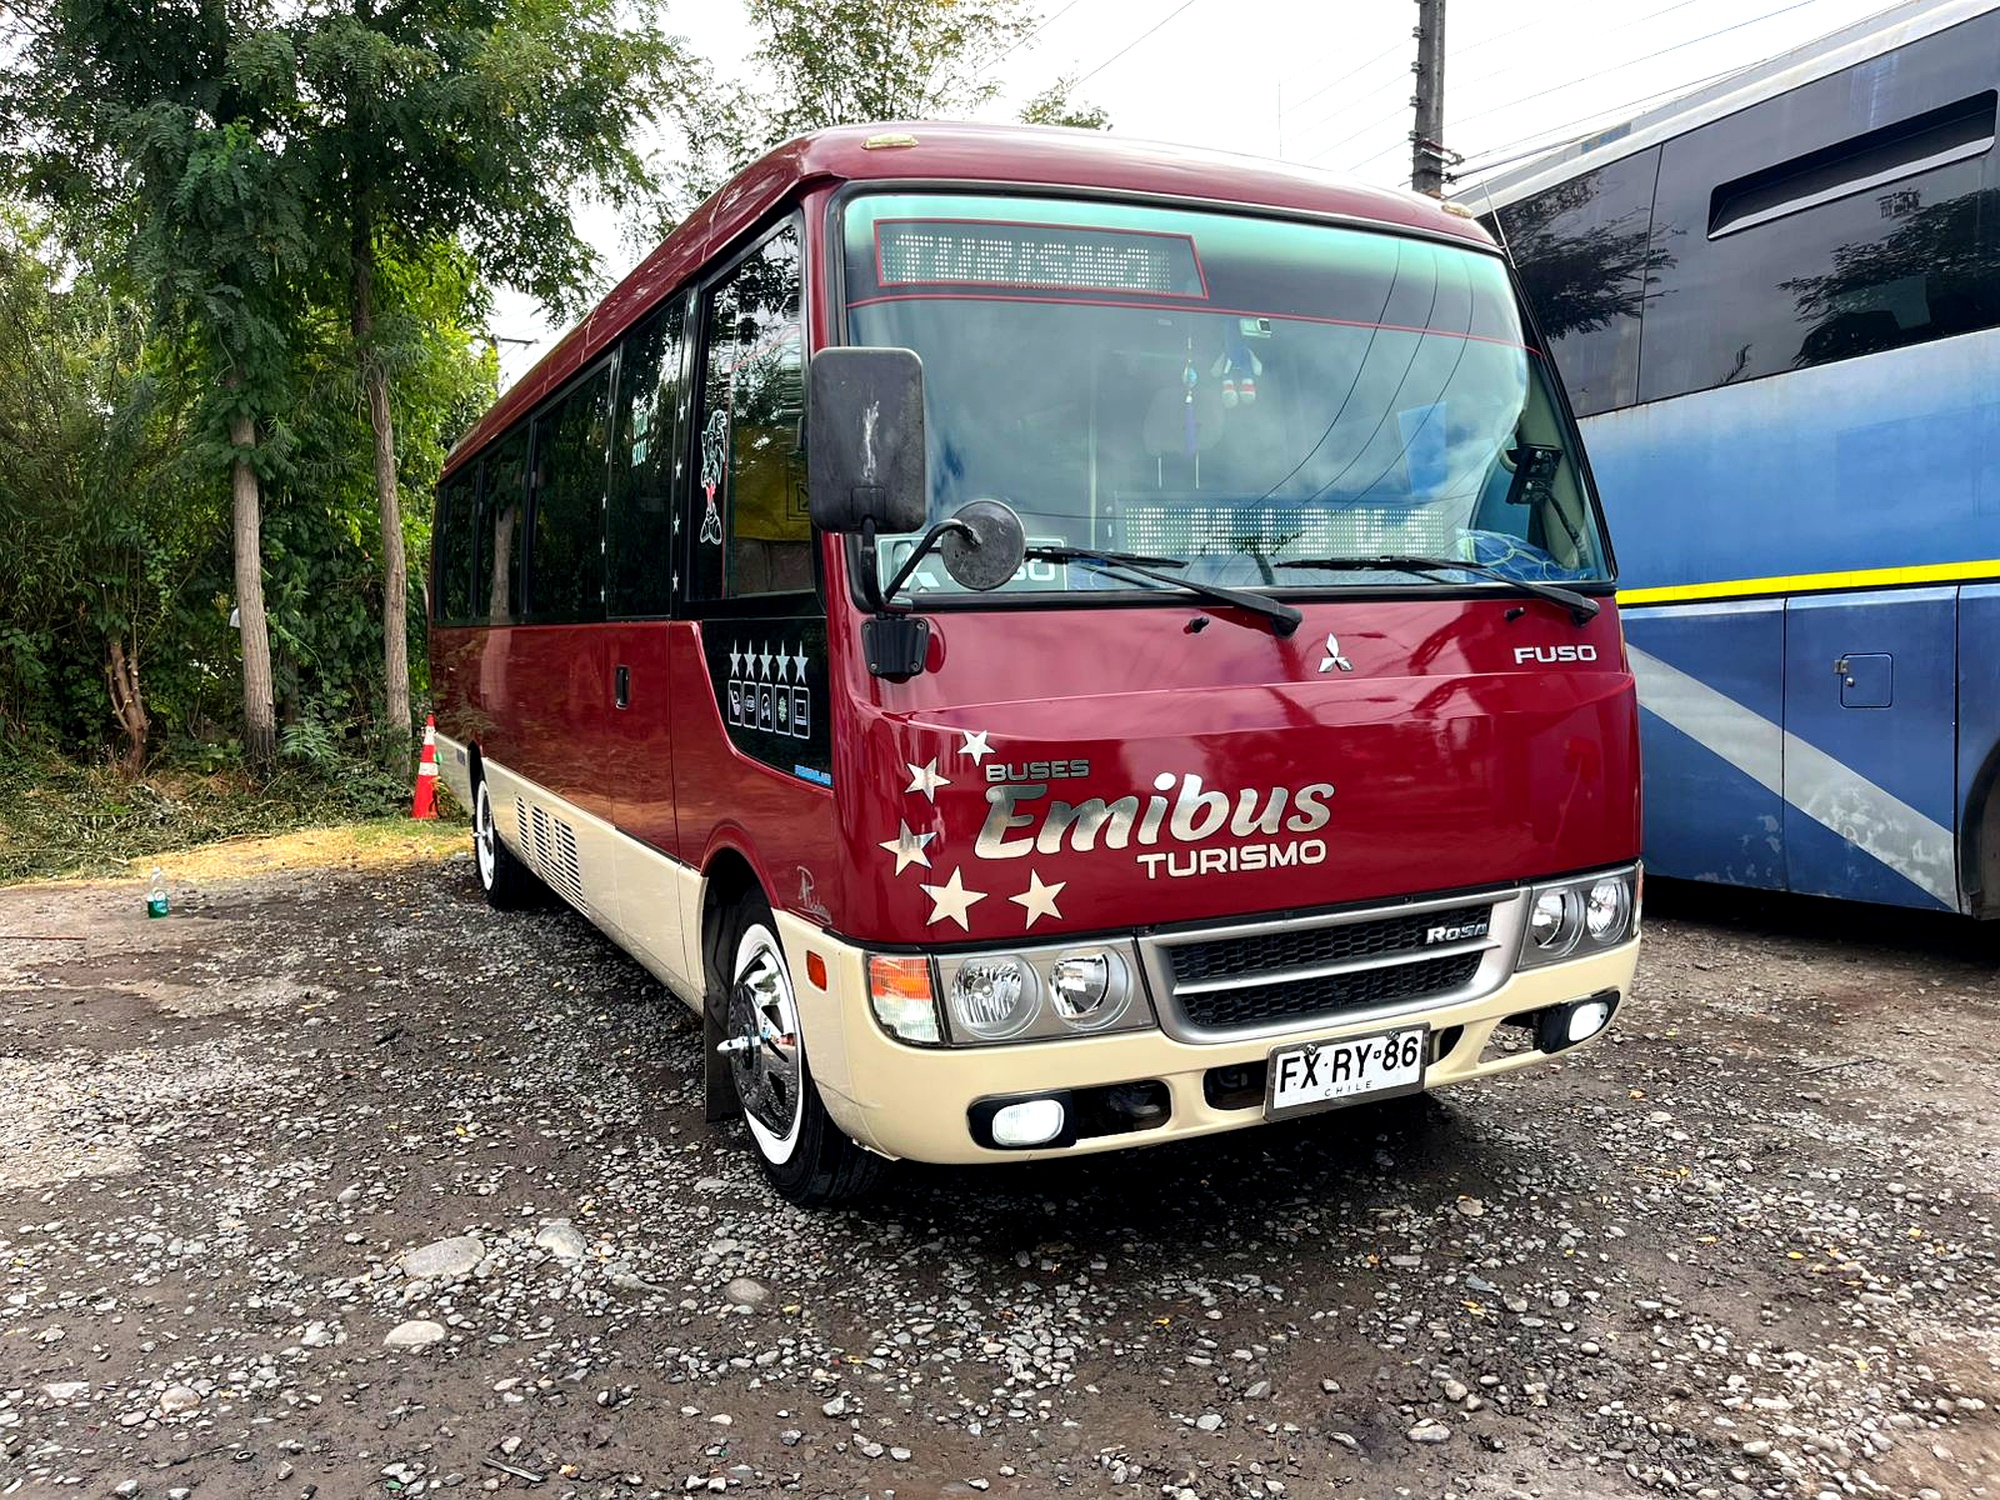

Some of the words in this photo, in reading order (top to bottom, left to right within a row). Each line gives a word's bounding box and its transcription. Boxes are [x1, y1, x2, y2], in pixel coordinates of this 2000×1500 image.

[895, 233, 1150, 289] TURISMO
[1513, 644, 1598, 665] FUSO
[985, 759, 1090, 782] BUSES
[974, 772, 1335, 860] Emibus
[1136, 839, 1327, 879] TURISMO
[1425, 923, 1489, 945] Rosa
[1324, 1080, 1373, 1097] CHILE
